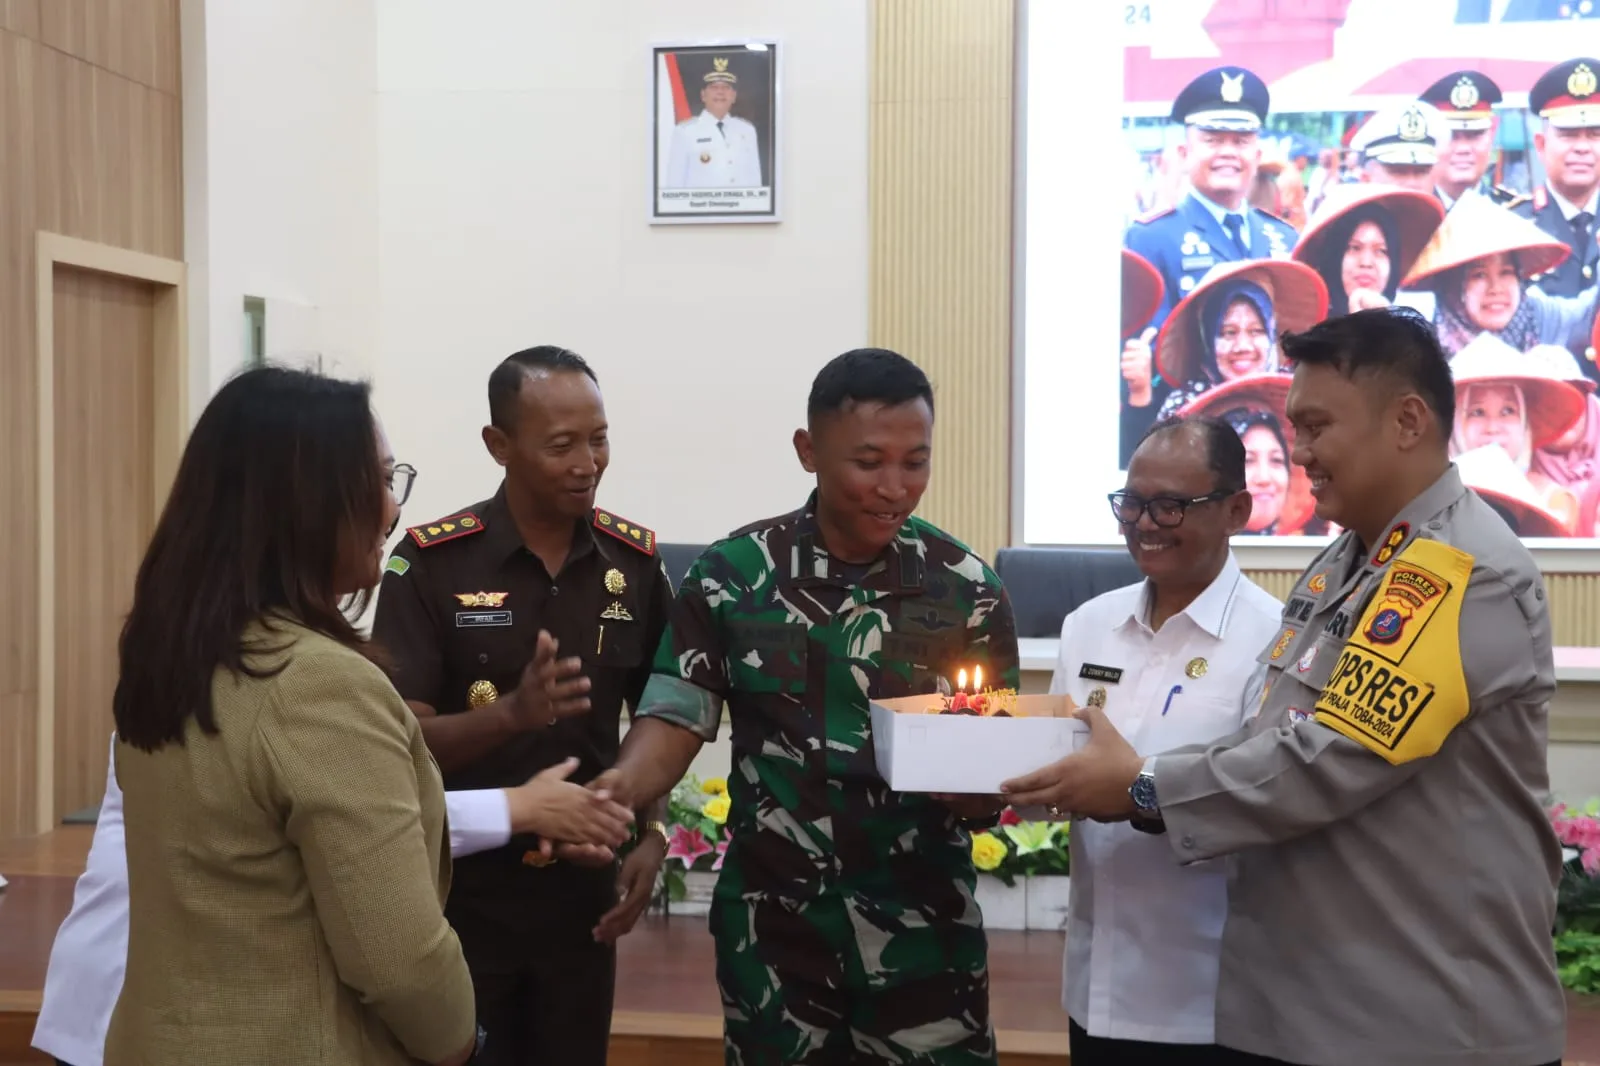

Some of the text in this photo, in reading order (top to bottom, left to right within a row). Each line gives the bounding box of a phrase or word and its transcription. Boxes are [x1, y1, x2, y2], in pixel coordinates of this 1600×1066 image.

[1394, 572, 1436, 594] POLRES
[1326, 692, 1396, 739] PRAJA TOBA-2024
